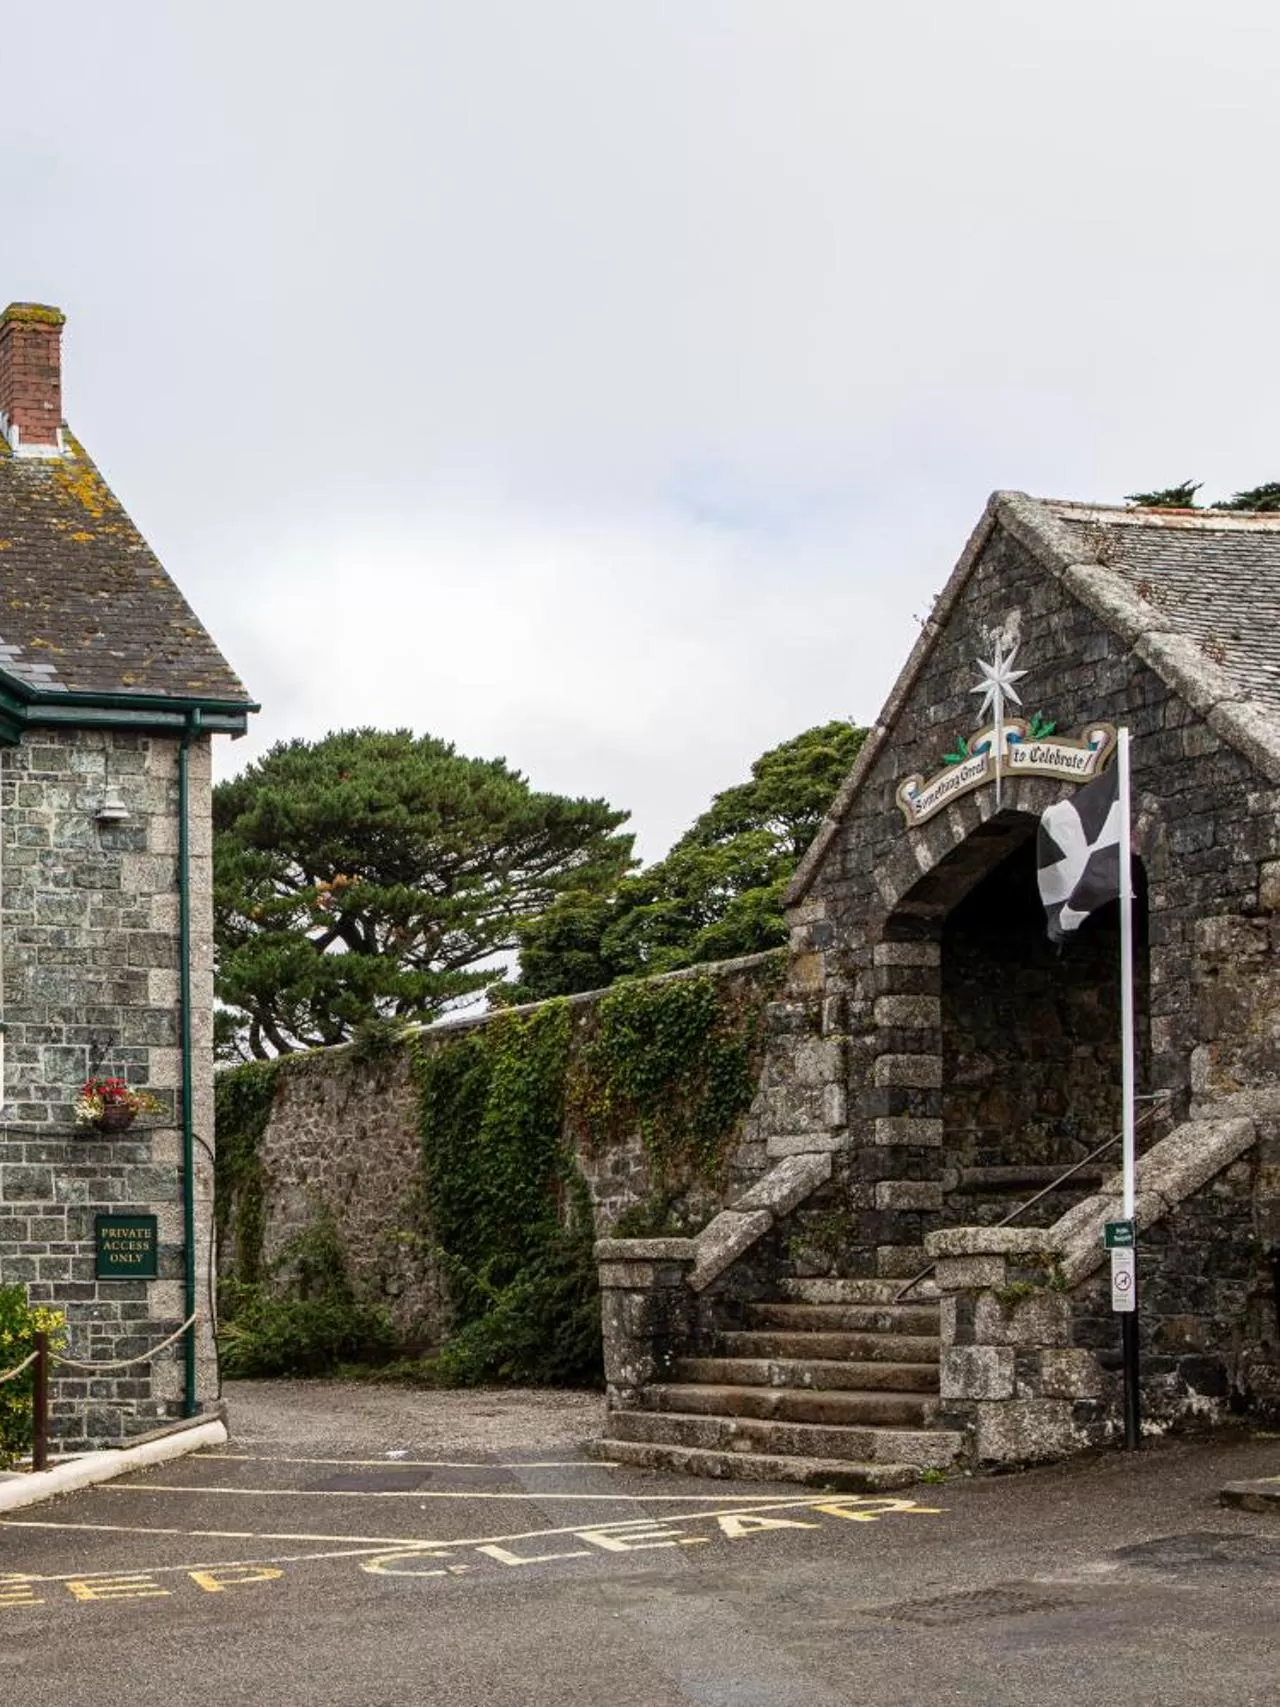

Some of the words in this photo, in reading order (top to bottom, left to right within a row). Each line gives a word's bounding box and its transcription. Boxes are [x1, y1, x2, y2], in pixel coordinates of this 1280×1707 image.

[1013, 748, 1027, 763] to
[101, 1227, 152, 1239] PRIVATE
[103, 1240, 150, 1251] ACCESS
[109, 1253, 143, 1264] ONLY
[359, 1496, 950, 1576] CLEAR
